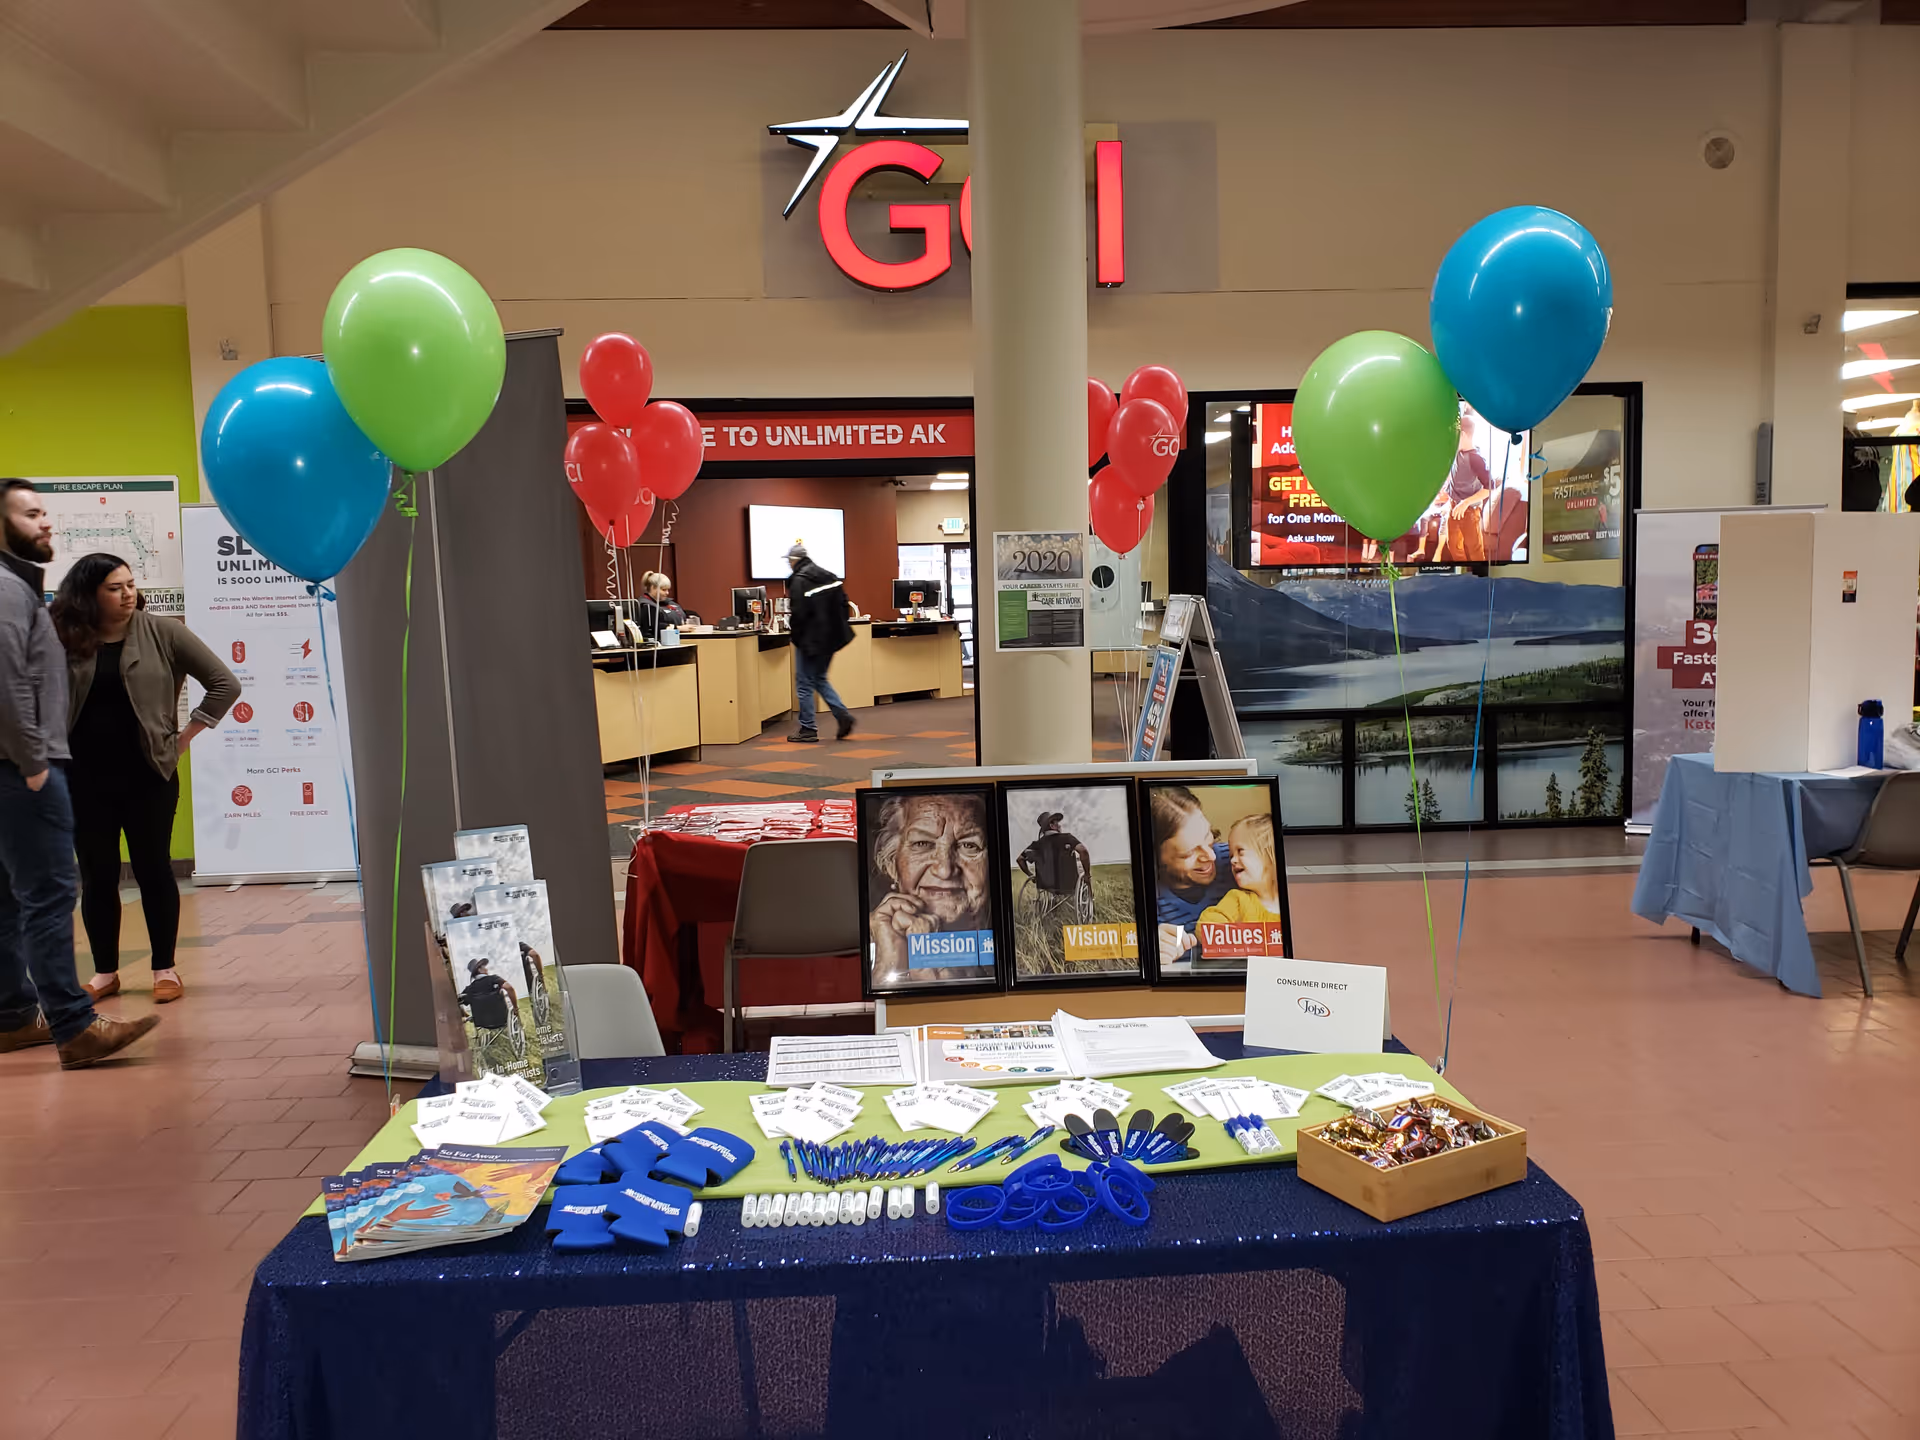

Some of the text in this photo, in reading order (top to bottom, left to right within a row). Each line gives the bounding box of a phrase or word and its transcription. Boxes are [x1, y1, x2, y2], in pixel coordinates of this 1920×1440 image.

[818, 139, 1125, 292] GI
[723, 426, 758, 447] TO
[766, 424, 903, 446] UNLIMITED
[909, 423, 946, 443] AK
[1269, 476, 1304, 491] GET
[1567, 498, 1597, 509] UNLIMITED
[1268, 513, 1345, 524] for One Mon
[1287, 534, 1304, 543] Ask
[1316, 534, 1335, 542] how
[1596, 530, 1608, 538] BEST
[1012, 550, 1072, 573] 2020
[231, 576, 261, 584] SOOO
[144, 594, 174, 604] CLOVER
[1056, 597, 1081, 605] NETWORK
[1682, 699, 1705, 707] Your
[1684, 709, 1708, 718] offer
[1066, 926, 1118, 946] Vision
[1202, 924, 1263, 946] Values
[911, 933, 976, 956] Mission
[1276, 978, 1348, 991] CONSUMER DIRECT
[1303, 1000, 1325, 1016] Jobs
[454, 1150, 470, 1158] Far
[471, 1152, 502, 1161] Away
